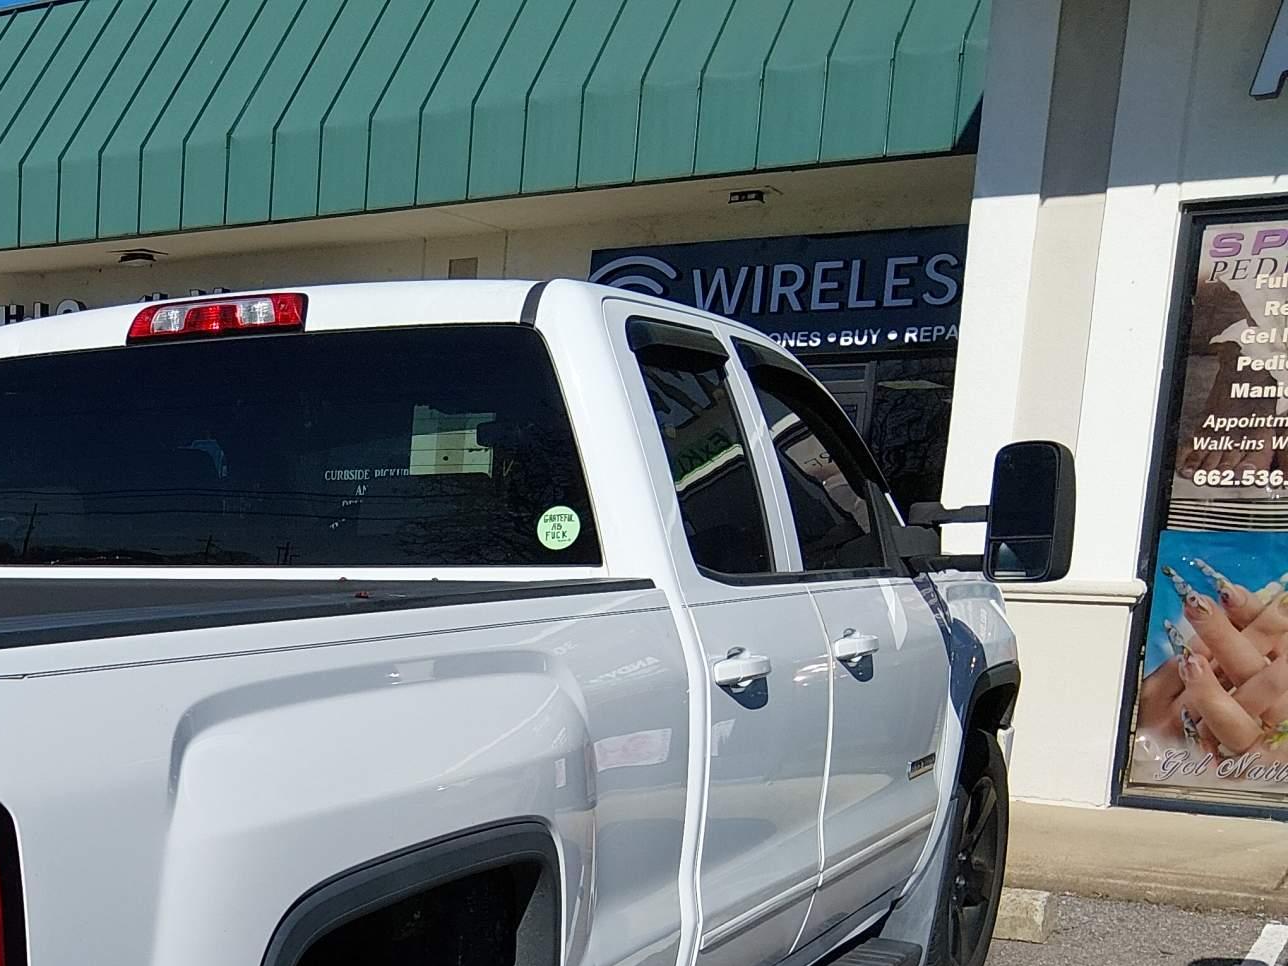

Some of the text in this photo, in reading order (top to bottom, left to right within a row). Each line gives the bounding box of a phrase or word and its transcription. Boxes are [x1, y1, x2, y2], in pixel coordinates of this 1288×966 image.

[839, 328, 881, 346] BUY
[1240, 327, 1277, 344] Gel
[1193, 435, 1265, 451] Walk-ins
[325, 469, 370, 481] CURBSIDE
[545, 530, 568, 541] FUCK
[1154, 748, 1288, 781] Gel Nail
